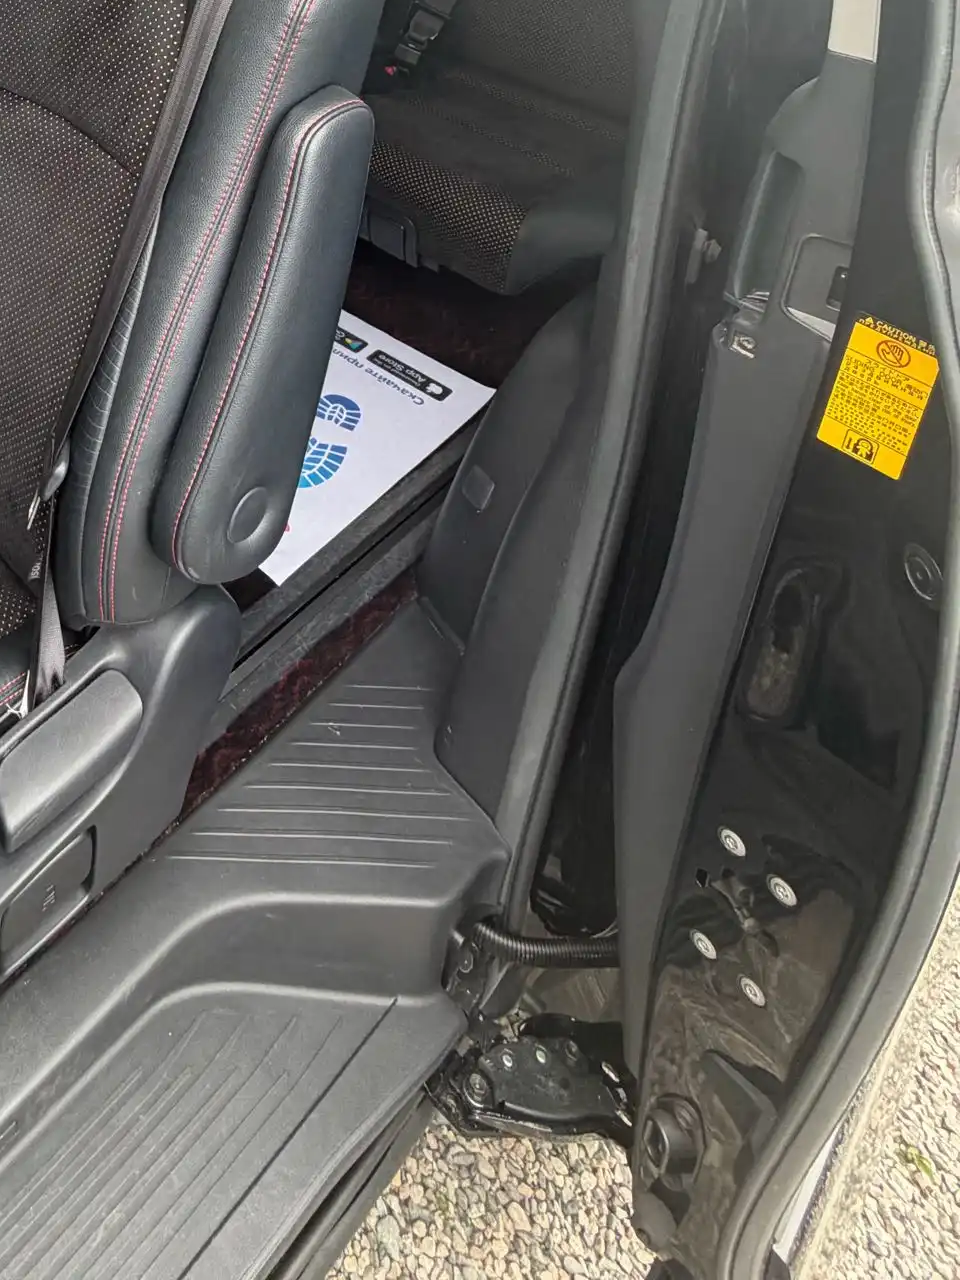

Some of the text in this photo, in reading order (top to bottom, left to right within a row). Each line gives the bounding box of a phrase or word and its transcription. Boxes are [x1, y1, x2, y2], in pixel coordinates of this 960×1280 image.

[875, 320, 917, 345] CAUTION
[378, 354, 427, 383] App Store
[365, 368, 424, 405] Скачайте
